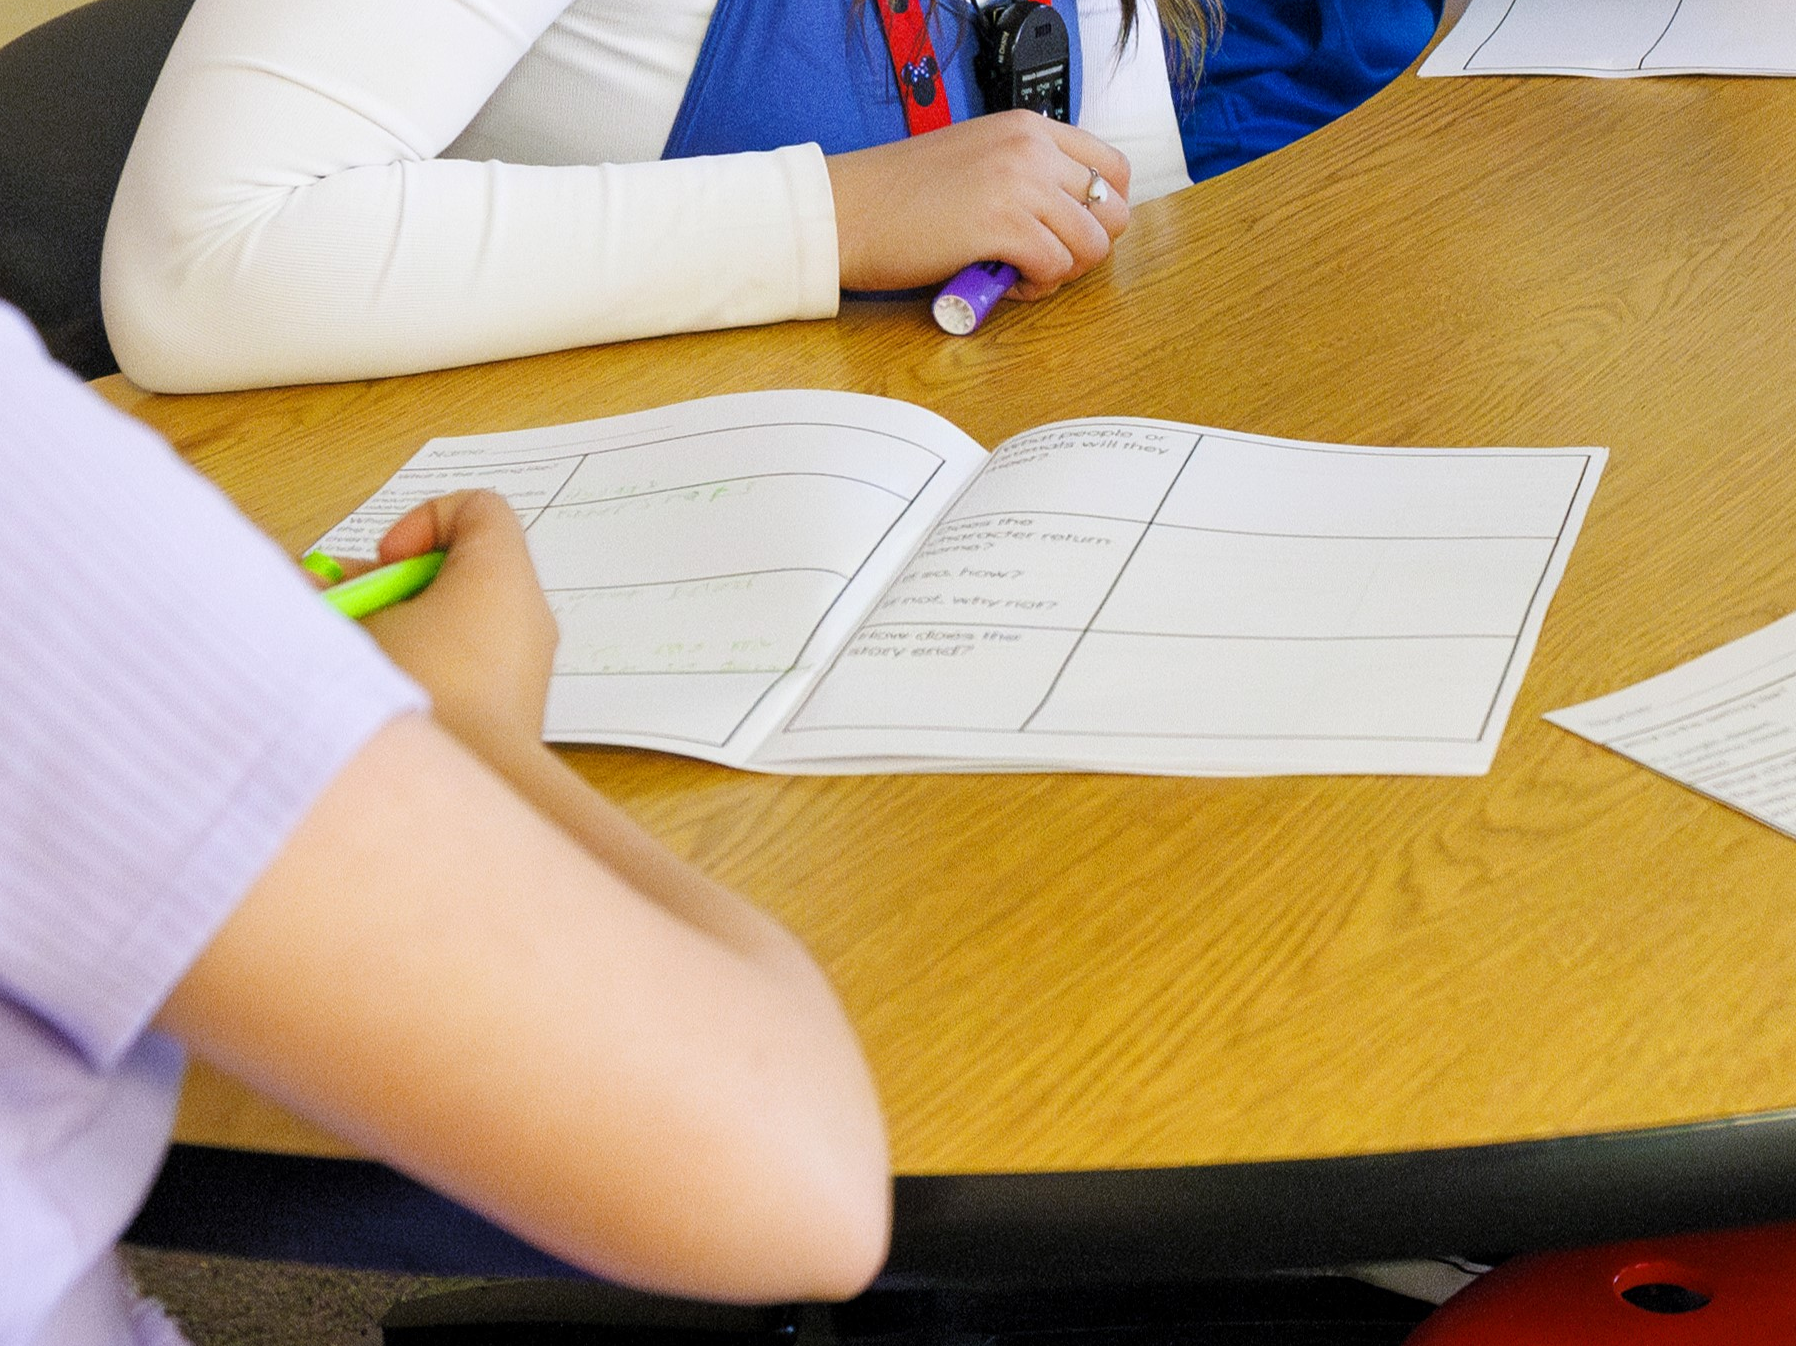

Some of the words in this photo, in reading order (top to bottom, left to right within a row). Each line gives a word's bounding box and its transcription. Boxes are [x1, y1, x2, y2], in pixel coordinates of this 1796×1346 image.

[1055, 429, 1133, 442] people
[1082, 439, 1117, 448] will
[1123, 442, 1170, 455] they
[998, 518, 1034, 526] the
[1041, 534, 1113, 544] return
[959, 567, 1026, 579] how?
[953, 595, 1000, 608] why
[1004, 599, 1060, 610] not?
[915, 629, 974, 641] does
[982, 630, 1021, 642] the
[847, 646, 906, 658] story
[912, 645, 975, 656] end?
